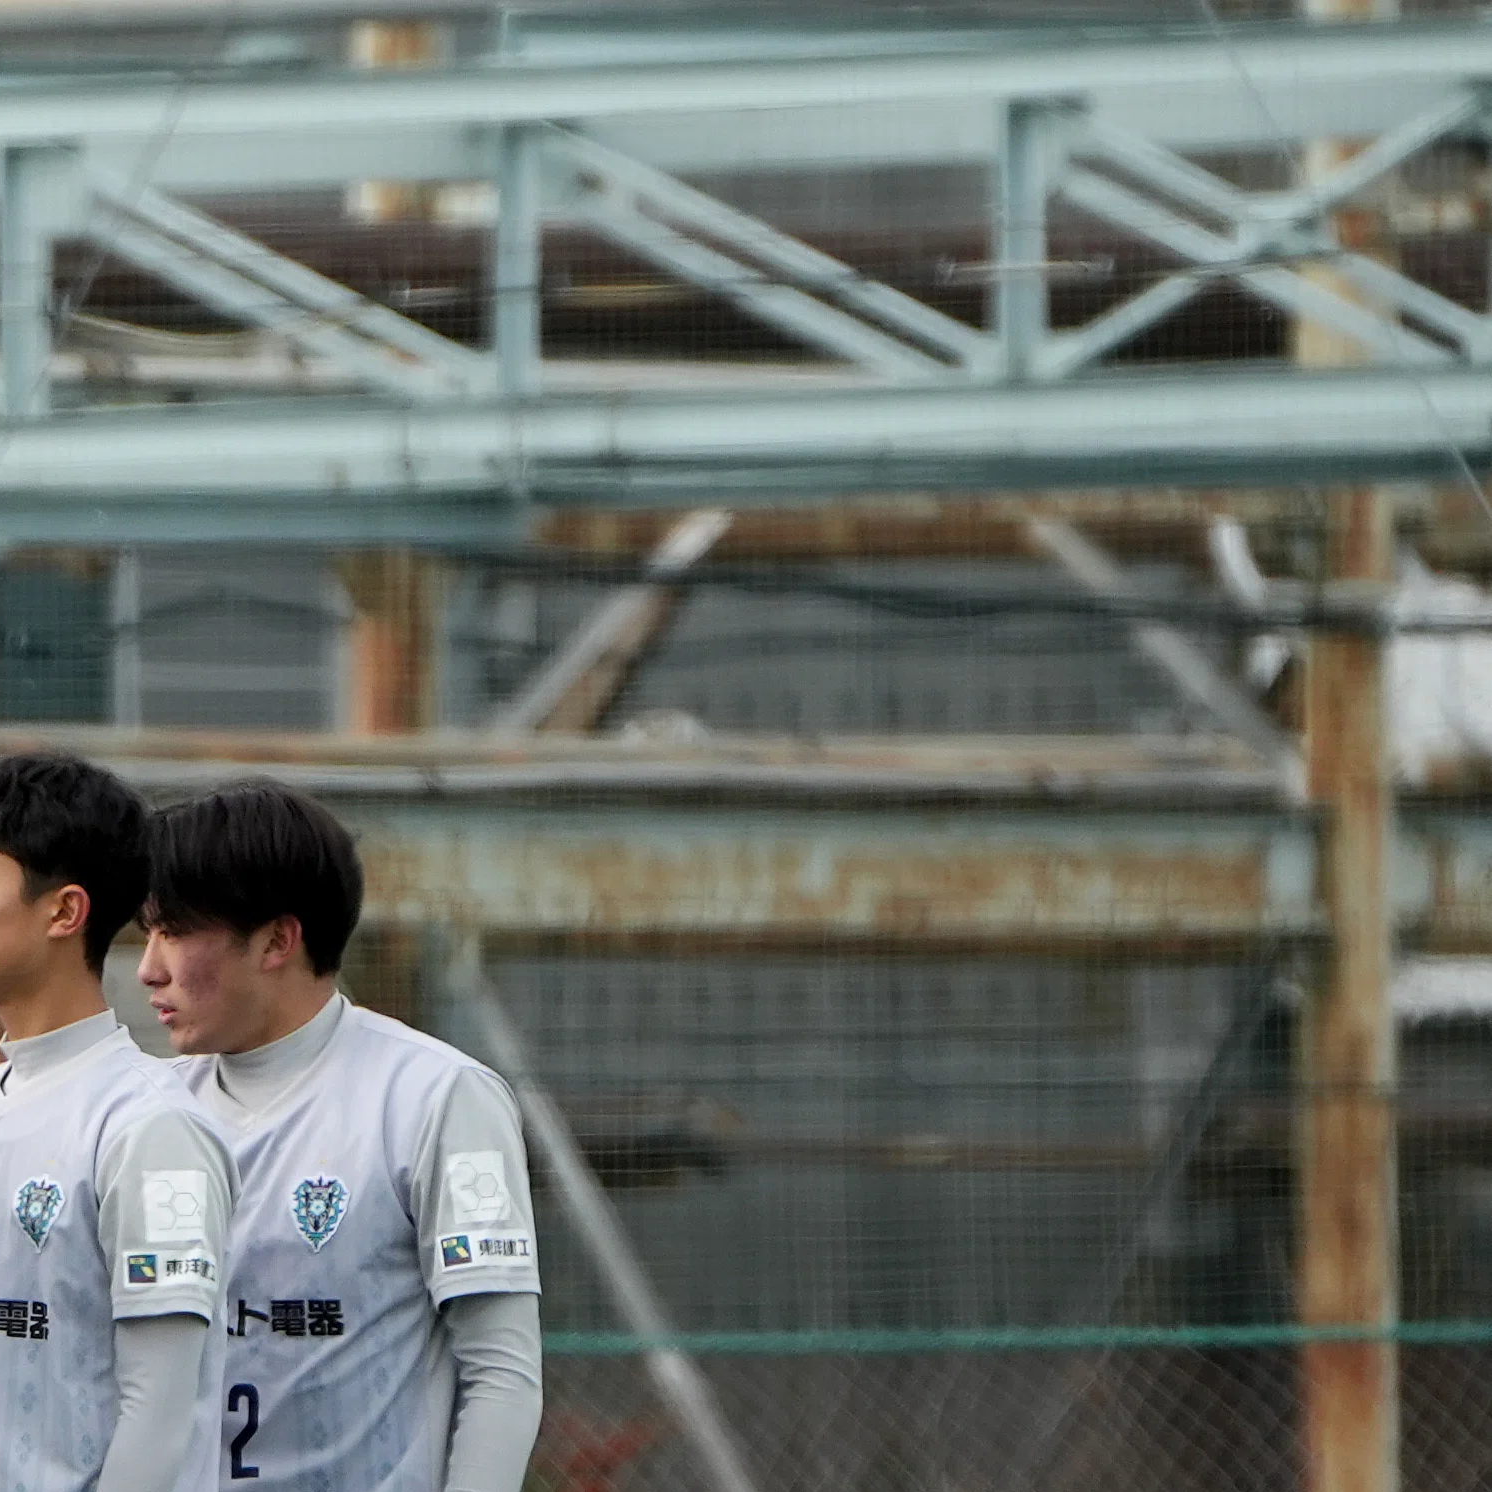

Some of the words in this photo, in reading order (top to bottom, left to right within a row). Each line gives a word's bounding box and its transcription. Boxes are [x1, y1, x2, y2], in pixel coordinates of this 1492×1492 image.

[227, 1298, 345, 1337] ト電器
[227, 1382, 260, 1480] 2
